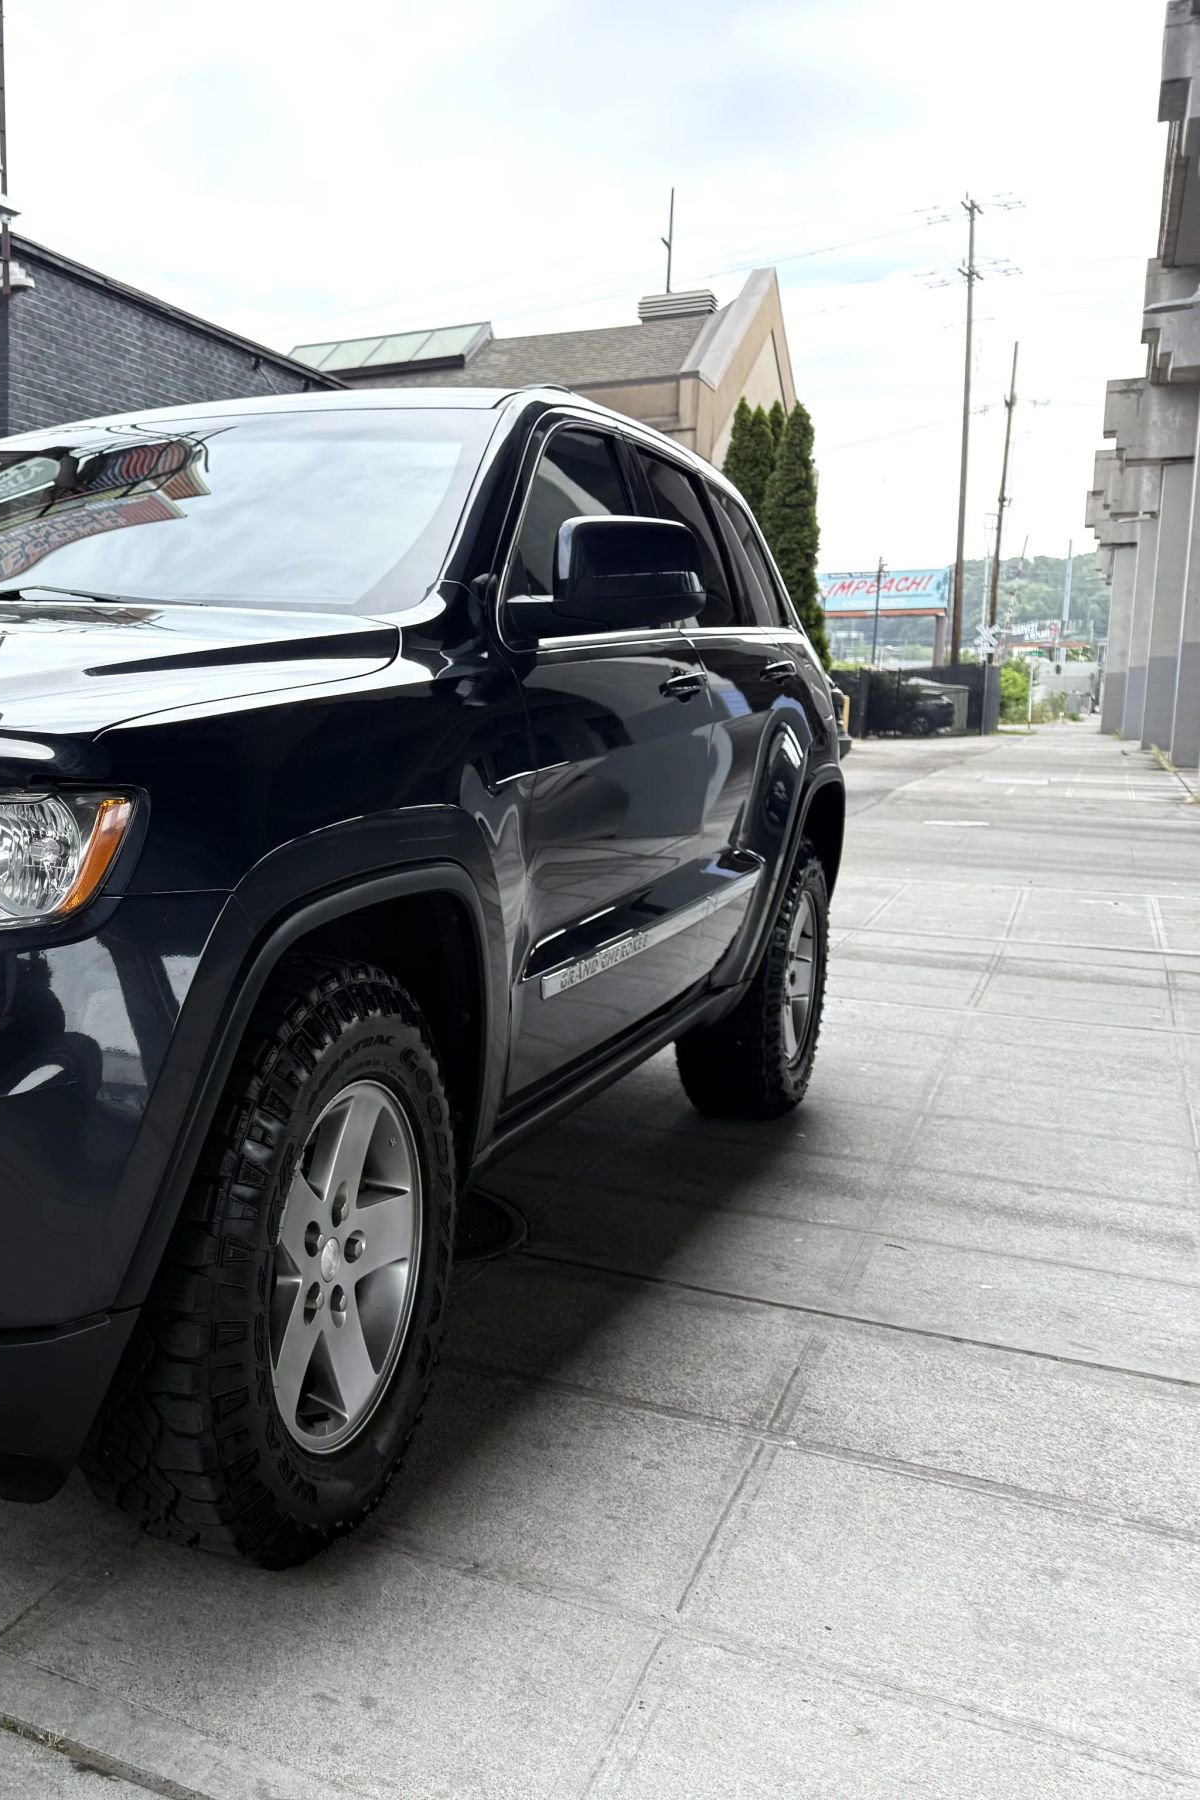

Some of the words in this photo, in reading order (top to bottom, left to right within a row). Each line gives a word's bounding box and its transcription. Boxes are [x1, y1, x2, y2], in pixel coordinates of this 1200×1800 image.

[826, 574, 934, 598] IMPEACH!
[560, 957, 598, 989] GRAND
[601, 934, 650, 969] CHEROKEE
